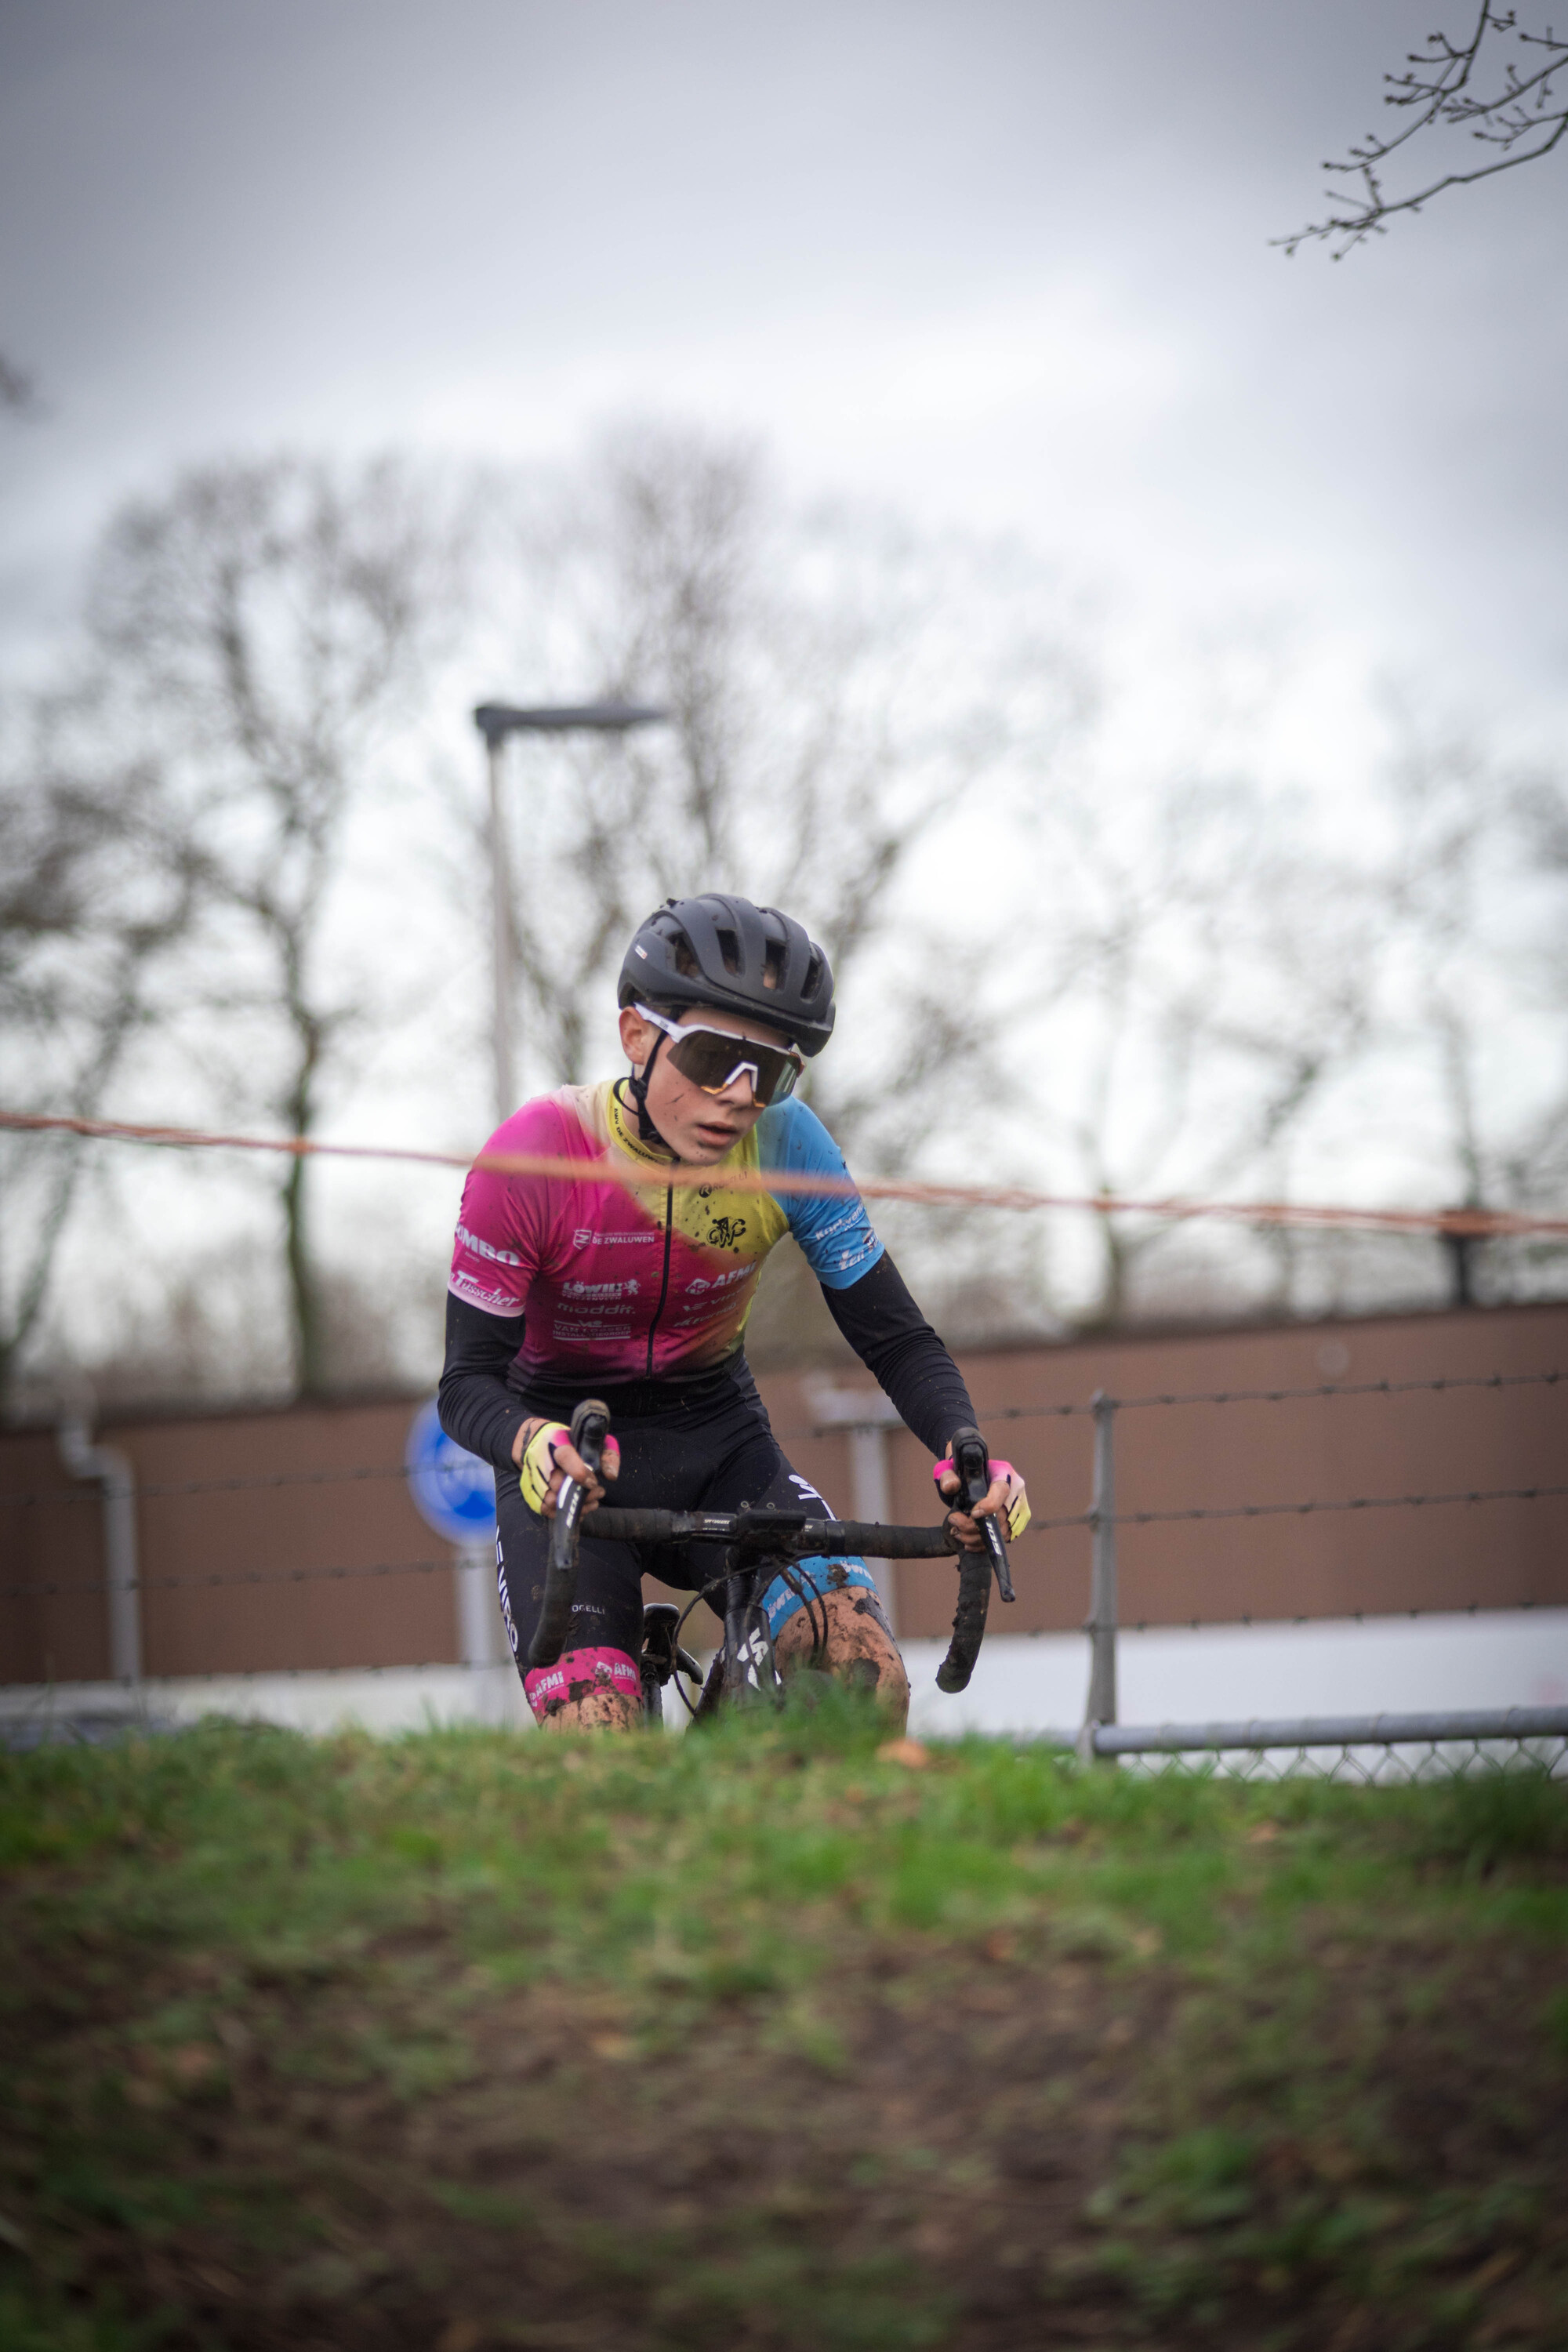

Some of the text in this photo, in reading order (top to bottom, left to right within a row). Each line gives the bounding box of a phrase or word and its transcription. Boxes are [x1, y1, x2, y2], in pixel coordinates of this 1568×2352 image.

[592, 1236, 655, 1245] DE ZWALUWEN
[455, 1269, 521, 1307] Tusscher
[711, 1261, 757, 1289] AFMI
[985, 1522, 1003, 1556] 105
[535, 1671, 564, 1697] AFMI
[614, 1662, 636, 1681] AFMI
